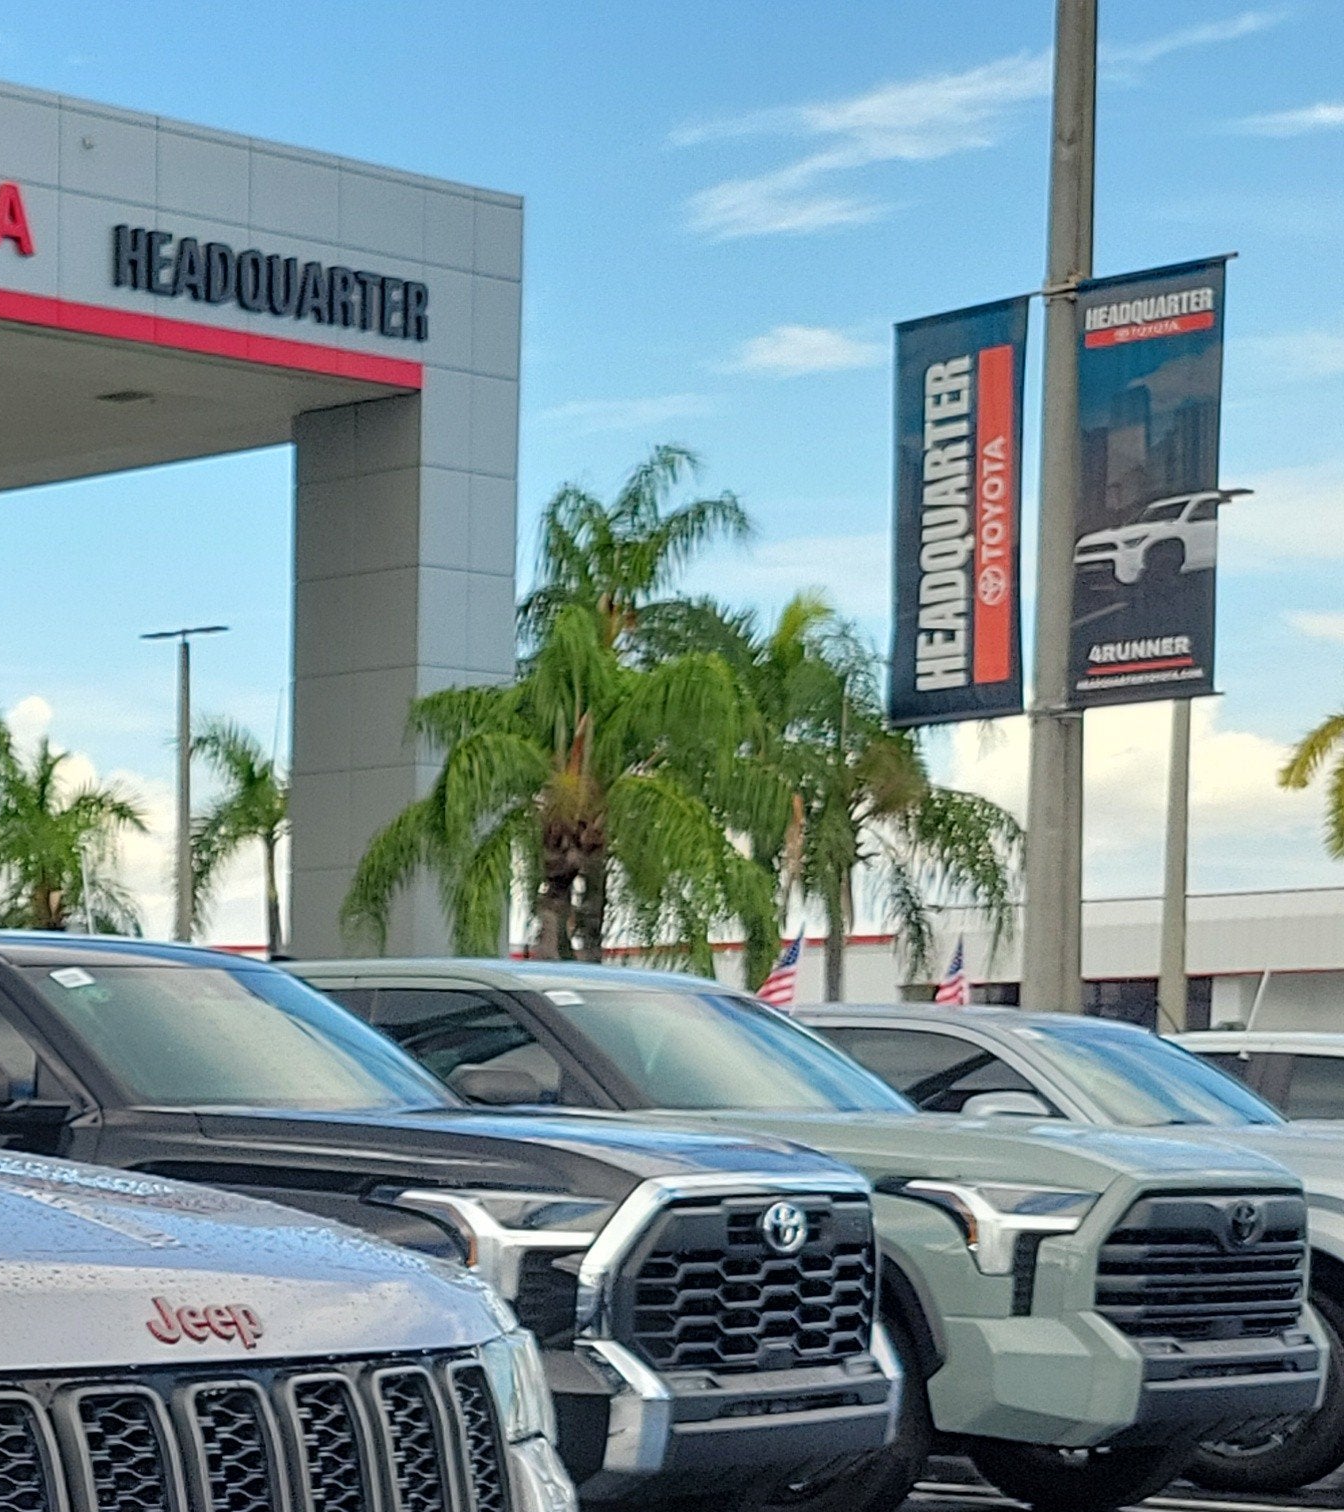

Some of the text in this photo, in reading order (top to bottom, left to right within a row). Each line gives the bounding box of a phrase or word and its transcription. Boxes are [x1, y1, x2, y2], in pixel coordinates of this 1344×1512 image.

[113, 224, 430, 341] HEADQUARTER
[1085, 287, 1213, 330] HEADQUARTER
[915, 354, 975, 692] HEADQUARTER
[981, 434, 1008, 563] TOYOTA
[1088, 635, 1191, 664] 4RUNNER
[146, 1295, 263, 1350] Jeep
